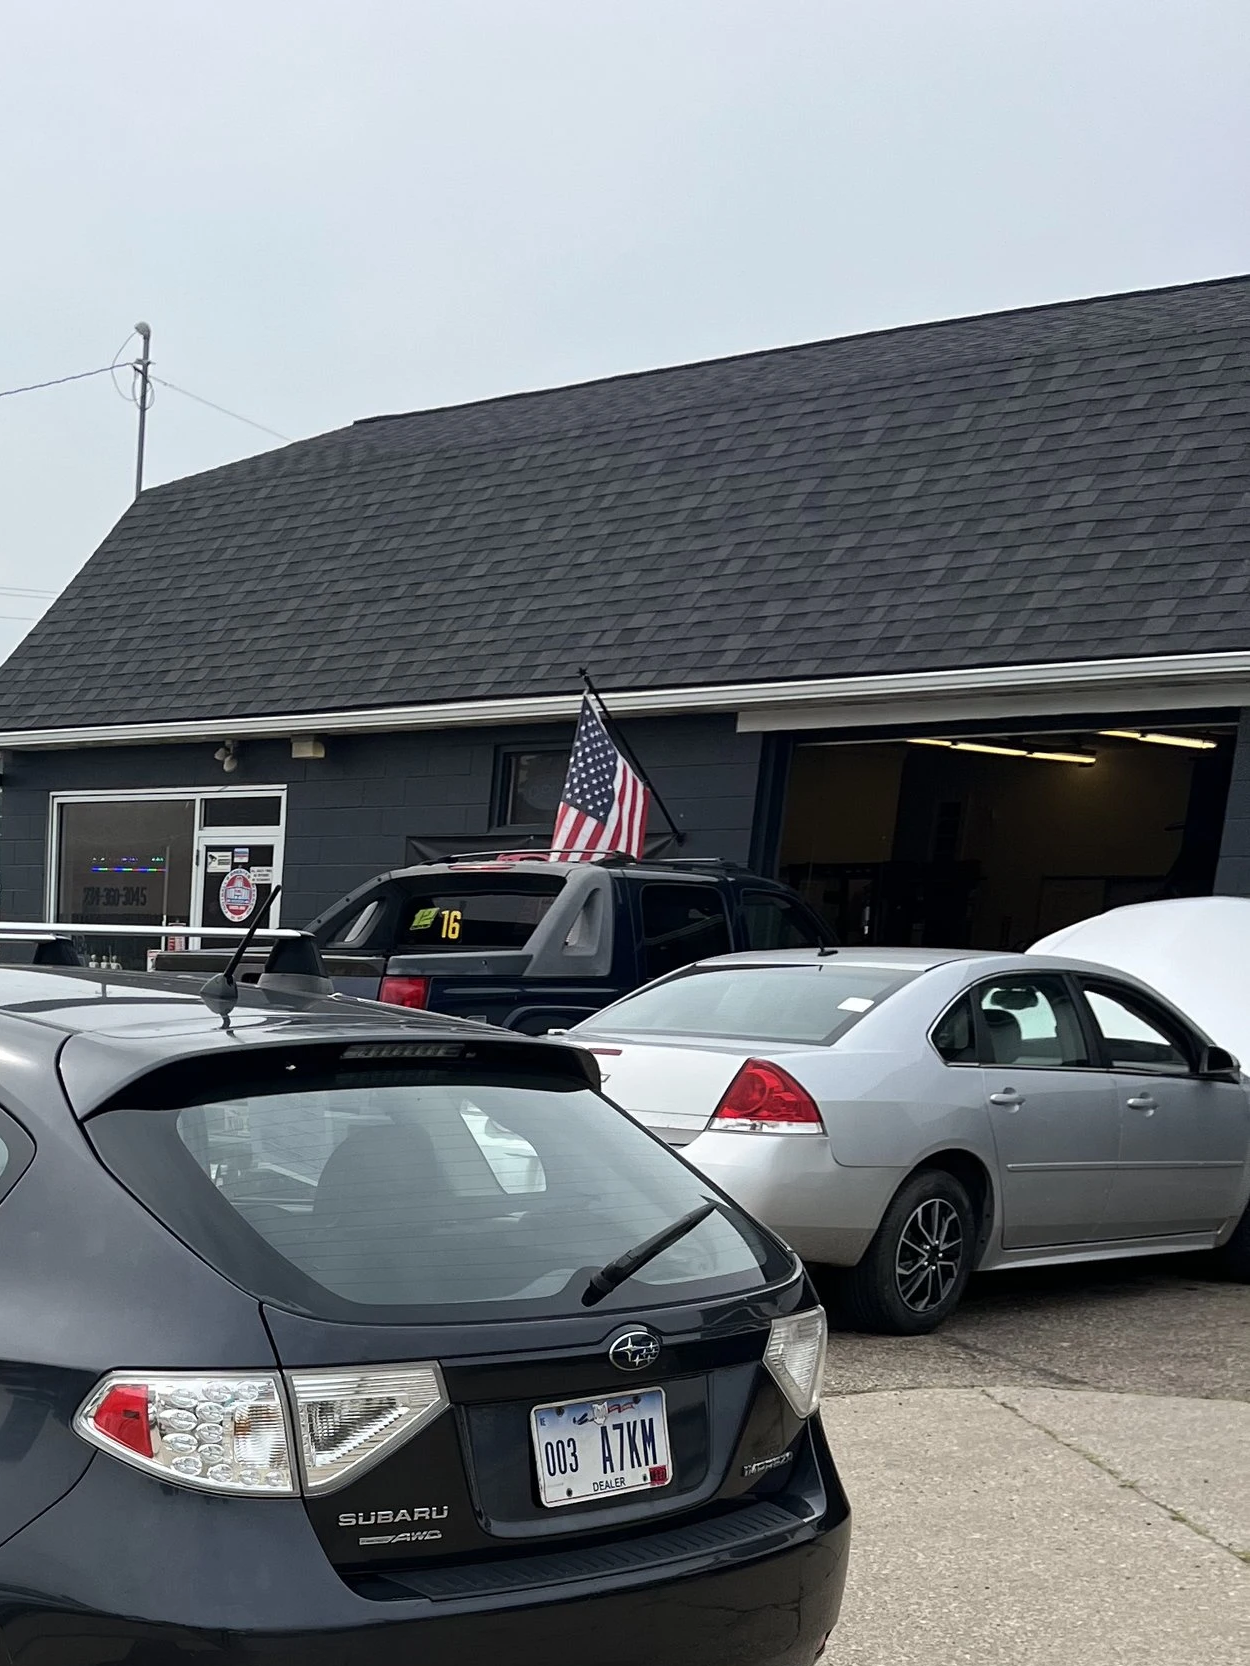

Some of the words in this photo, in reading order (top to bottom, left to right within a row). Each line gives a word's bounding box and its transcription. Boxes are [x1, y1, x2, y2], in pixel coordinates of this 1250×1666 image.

[441, 910, 462, 939] 16
[544, 1437, 579, 1477] 003
[600, 1417, 658, 1475] A7KM
[592, 1476, 626, 1492] DEALER
[338, 1506, 449, 1527] SUBARU
